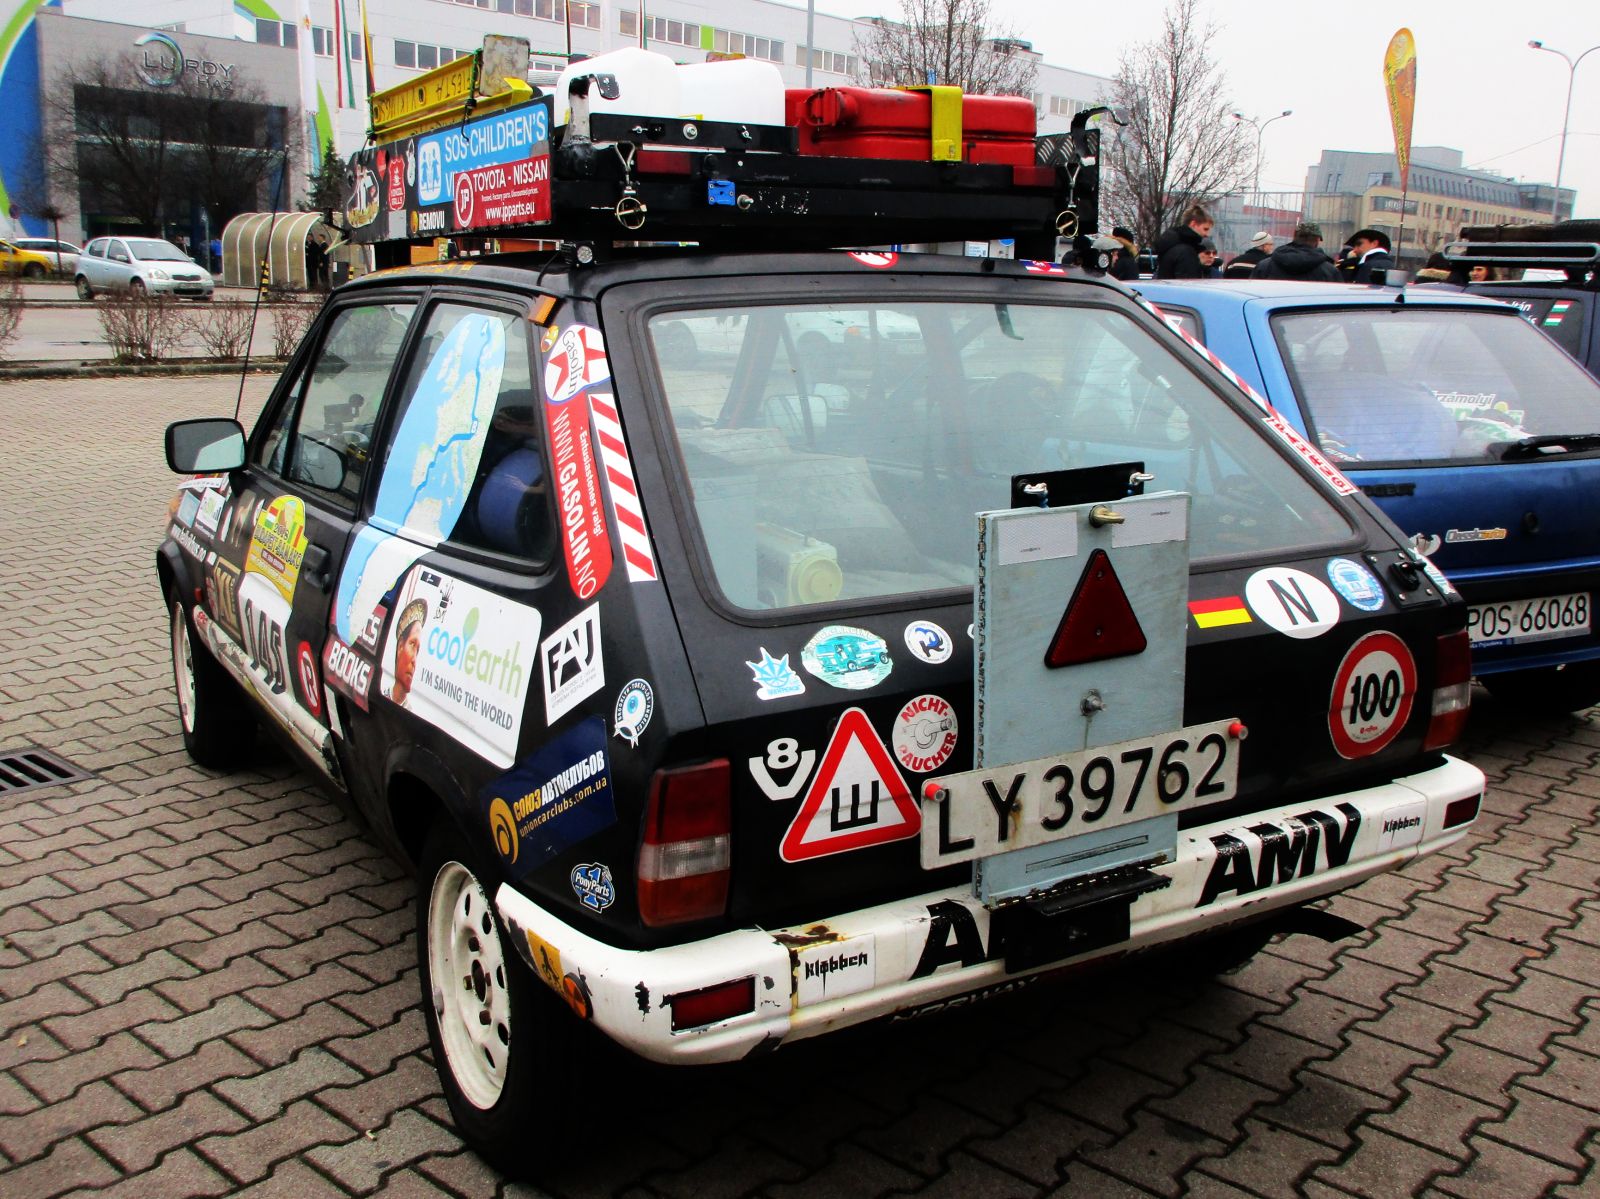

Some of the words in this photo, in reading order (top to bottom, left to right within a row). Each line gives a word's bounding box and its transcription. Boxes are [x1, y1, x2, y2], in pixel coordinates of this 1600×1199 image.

[145, 52, 235, 77] LURDY
[473, 168, 506, 193] TOYOTA
[513, 159, 548, 186] NISSAN
[485, 201, 535, 222] www.jpparts.eu
[562, 330, 583, 396] Gasolin
[552, 407, 597, 599] WWW.GASOLIN.NO
[579, 431, 598, 507] Entusiastenes
[591, 507, 603, 536] valg!
[1266, 577, 1320, 626] N
[1465, 605, 1512, 638] POS
[1520, 594, 1587, 633] 66068
[328, 640, 371, 696] BOOKS
[421, 667, 433, 687] I'M
[434, 675, 462, 703] SAVING
[465, 691, 480, 712] THE
[481, 699, 513, 731] WORLD
[1349, 669, 1400, 724] 100
[519, 776, 608, 838] unioncarclubs.com.ua
[939, 773, 1027, 855] LY
[1041, 733, 1228, 831] 39762
[1195, 802, 1362, 908] AMV
[575, 871, 610, 897] PonyParts
